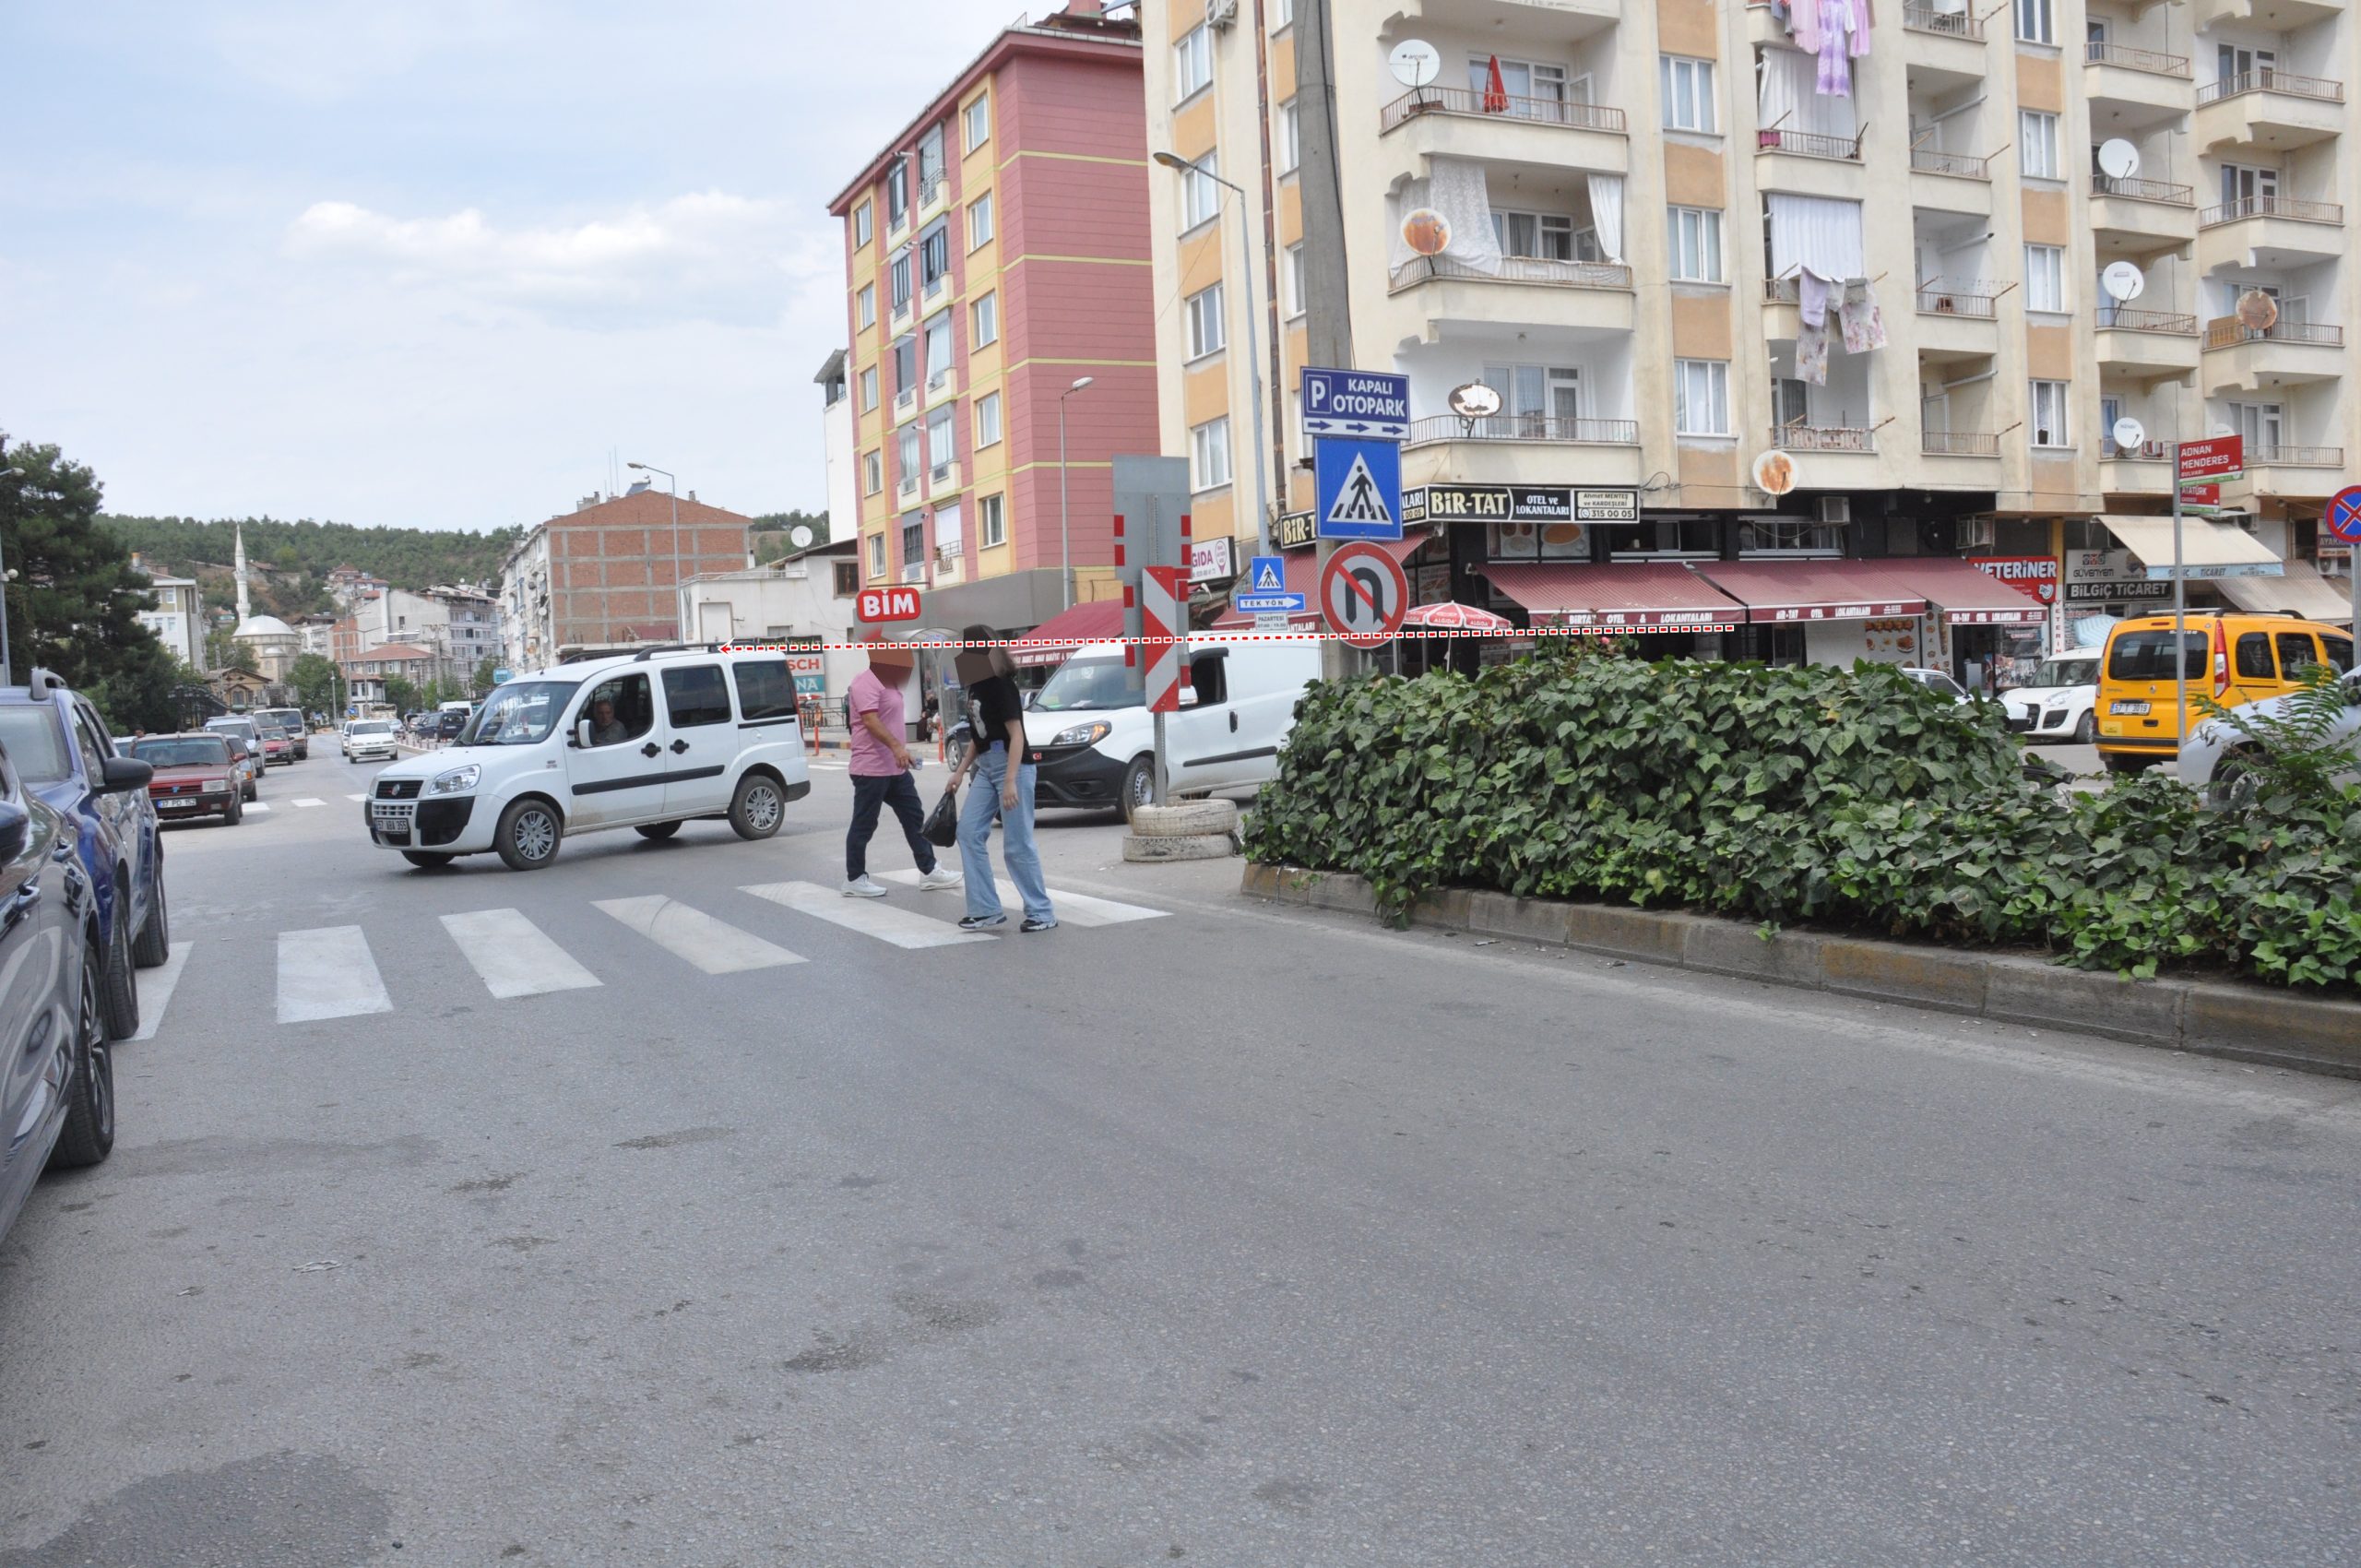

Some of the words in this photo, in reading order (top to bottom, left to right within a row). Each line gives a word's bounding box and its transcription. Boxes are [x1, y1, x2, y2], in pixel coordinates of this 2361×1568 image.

[1347, 378, 1393, 395] KAPALI
[1311, 380, 1326, 408] P
[1333, 394, 1406, 417] OTOPARK
[2180, 445, 2212, 457] ADNAN
[2181, 455, 2229, 469] MENDERES
[1526, 495, 1546, 505] OTEL
[1515, 505, 1570, 516] LOKANTALARI
[863, 589, 915, 617] BİM
[1265, 598, 1284, 606] YÖN
[1607, 613, 1625, 624] OTEL
[1639, 613, 1646, 623] &
[1660, 612, 1713, 624] LOKANTALARI
